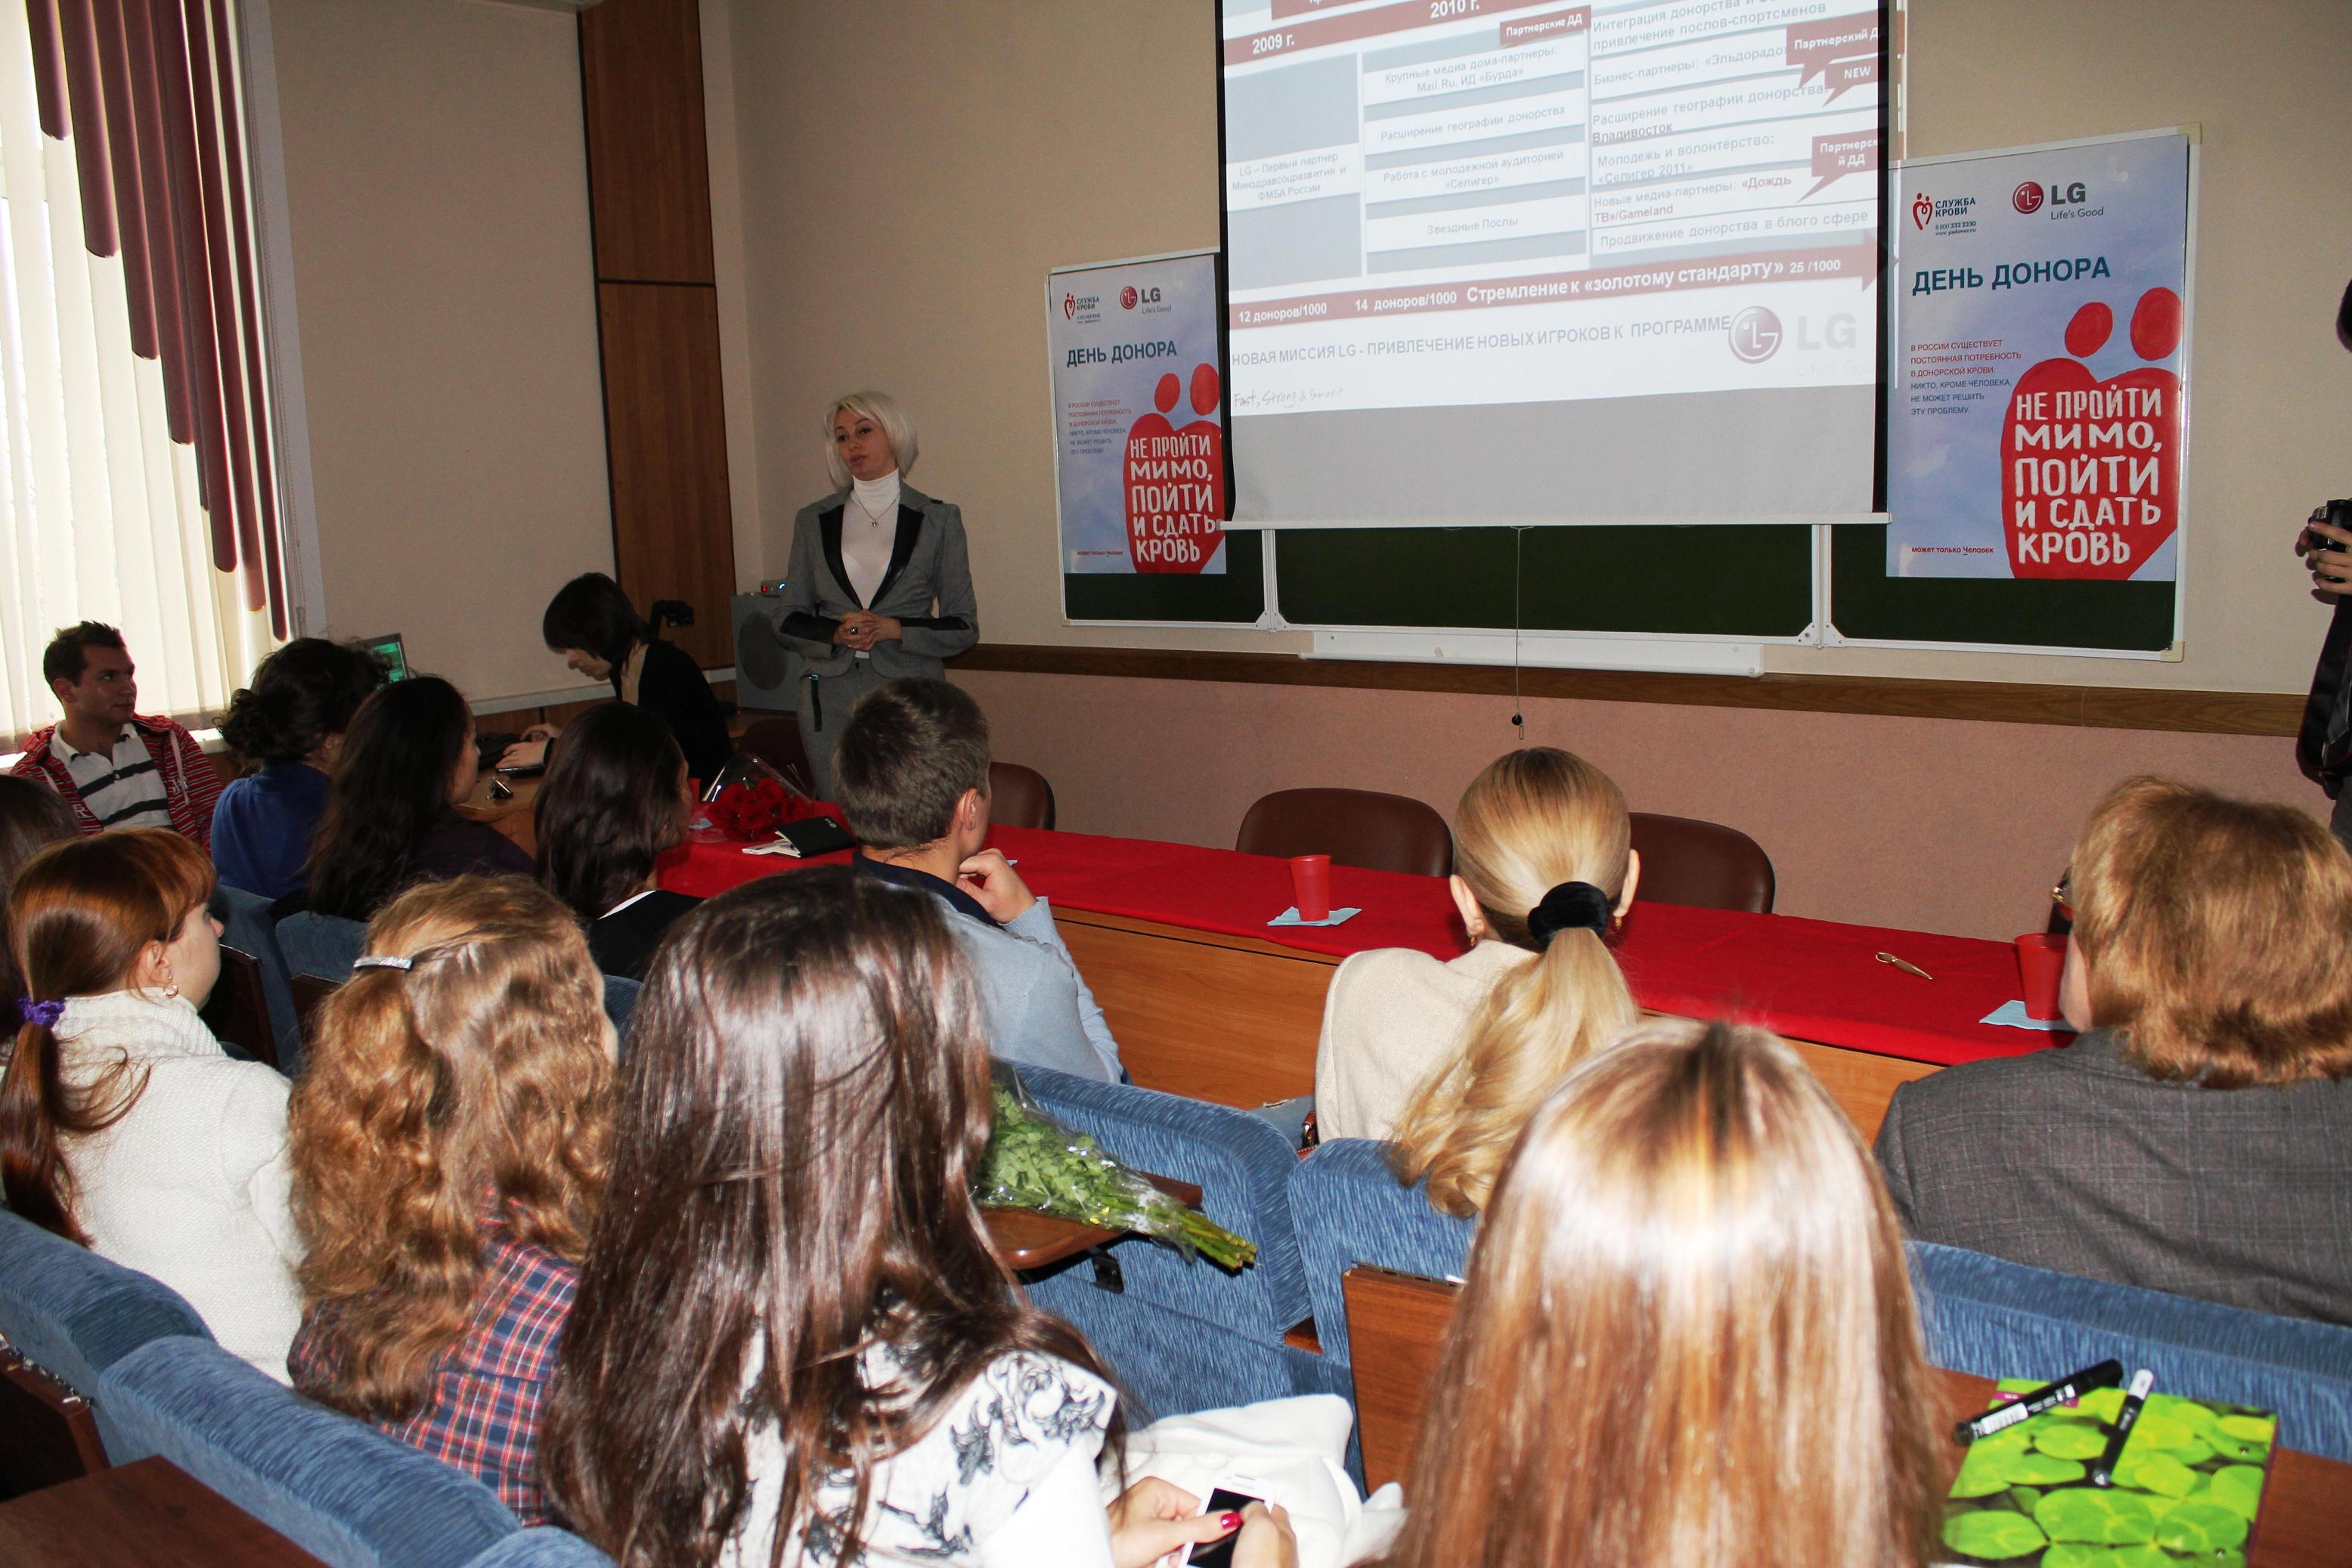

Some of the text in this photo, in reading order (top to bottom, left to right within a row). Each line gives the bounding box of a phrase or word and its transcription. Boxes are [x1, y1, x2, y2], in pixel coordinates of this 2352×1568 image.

[1430, 0, 1466, 19] 2010
[1593, 11, 1666, 33] Интеграция
[1670, 0, 1740, 20] донорства
[1505, 13, 1583, 38] Партнерские ДД
[1593, 3, 1827, 51] привлечение послов-спортсменов
[1253, 33, 1295, 55] 2009 г.
[1794, 29, 1868, 51] Партнерский
[1385, 46, 1558, 84] Крупные медиа дома-партнеры:
[1461, 74, 1477, 86] ИД
[1480, 67, 1524, 82] «Бурда»
[1594, 46, 1786, 85] Бизнес-партнеры: «Эльдорадо
[1844, 66, 1872, 79] NEW
[1593, 104, 1669, 126] Расширение
[1673, 93, 1743, 117] географии
[1381, 106, 1565, 142] Расширение географии донорства
[1593, 122, 1673, 145] Владивосток
[1239, 166, 1252, 176] LG
[1262, 161, 1298, 173] Первый
[1300, 153, 1338, 166] партнер
[1384, 171, 1419, 182] Работа
[1431, 160, 1498, 177] молодежной
[1501, 150, 1564, 168] аудиторией
[1597, 150, 1662, 168] Молодежь
[1666, 148, 1673, 158] и
[1847, 153, 1866, 168] ДД
[1340, 166, 1346, 175] и
[1445, 175, 1499, 189] «Селигер»
[1598, 162, 1694, 185] «Селигер 2011»
[1257, 184, 1321, 200] ФМБА России
[1594, 176, 1792, 209] Новые медиа-партнеры: «Дождь
[1935, 196, 1976, 209] СЛУЖБА
[2050, 181, 2087, 206] LG
[1935, 206, 1968, 218] КРОВИ
[2050, 206, 2105, 221] Life's Good
[1427, 218, 1519, 234] Звездные Послы
[1601, 211, 1869, 248] Продвижение донорства в блого сфере
[1790, 259, 1842, 274] 25 /1000
[1912, 256, 2111, 296] ДЕНЬ ДОНОРА
[1467, 259, 1784, 303] Стремление к «золотому стандарту»
[1077, 296, 1101, 305] СЛУЖБА
[1141, 287, 1161, 304] LG
[1355, 291, 1458, 311] 14 доноров/1000
[1156, 305, 1172, 314] Good
[1239, 302, 1328, 324] 12 доноров/1000
[1232, 350, 1276, 367] НОВАЯ
[1279, 345, 1336, 363] МИССИЯ
[1338, 343, 1357, 358] LG
[1367, 335, 1475, 356] ПРИВЛЕЧЕНИЕ
[1477, 332, 1535, 350] НОВЫХ
[1538, 326, 1610, 346] ИГРОКОВ
[1613, 324, 1623, 339] К
[1631, 315, 1731, 337] ПРОГРАММЕ
[1796, 312, 1858, 351] LG
[1067, 340, 1177, 368] ДЕНЬ ДОНОРА
[1917, 342, 1950, 352] РОССИИ
[1951, 339, 2003, 350] СУЩЕСТВУЕТ
[1910, 352, 2022, 364] ПОСТОЯННАЯ ПОТРЕБНОСТЬ
[1917, 367, 1966, 377] ДОНОРСКОЙ
[1939, 380, 1966, 389] КРОМЕ
[1922, 394, 1951, 402] МОЖЕТ
[1952, 392, 1985, 401] РЕШИТЬ
[2016, 384, 2161, 421] НЕ ПРОЙТИ
[1130, 432, 1211, 459] НЕ ПРОЙТИ
[2015, 421, 2162, 452] МИМО,
[1130, 458, 1213, 481] МИМО,
[2014, 454, 2159, 497] ПОЙТИ
[1131, 482, 1214, 514] ПОЙТИ
[2016, 495, 2161, 531] И СДАТЬ
[1133, 513, 1216, 538] И СДАТЬ
[1136, 538, 1201, 563] КРОВЬ
[1962, 545, 1994, 556] Человек
[2017, 531, 2130, 566] КРОВЬ
